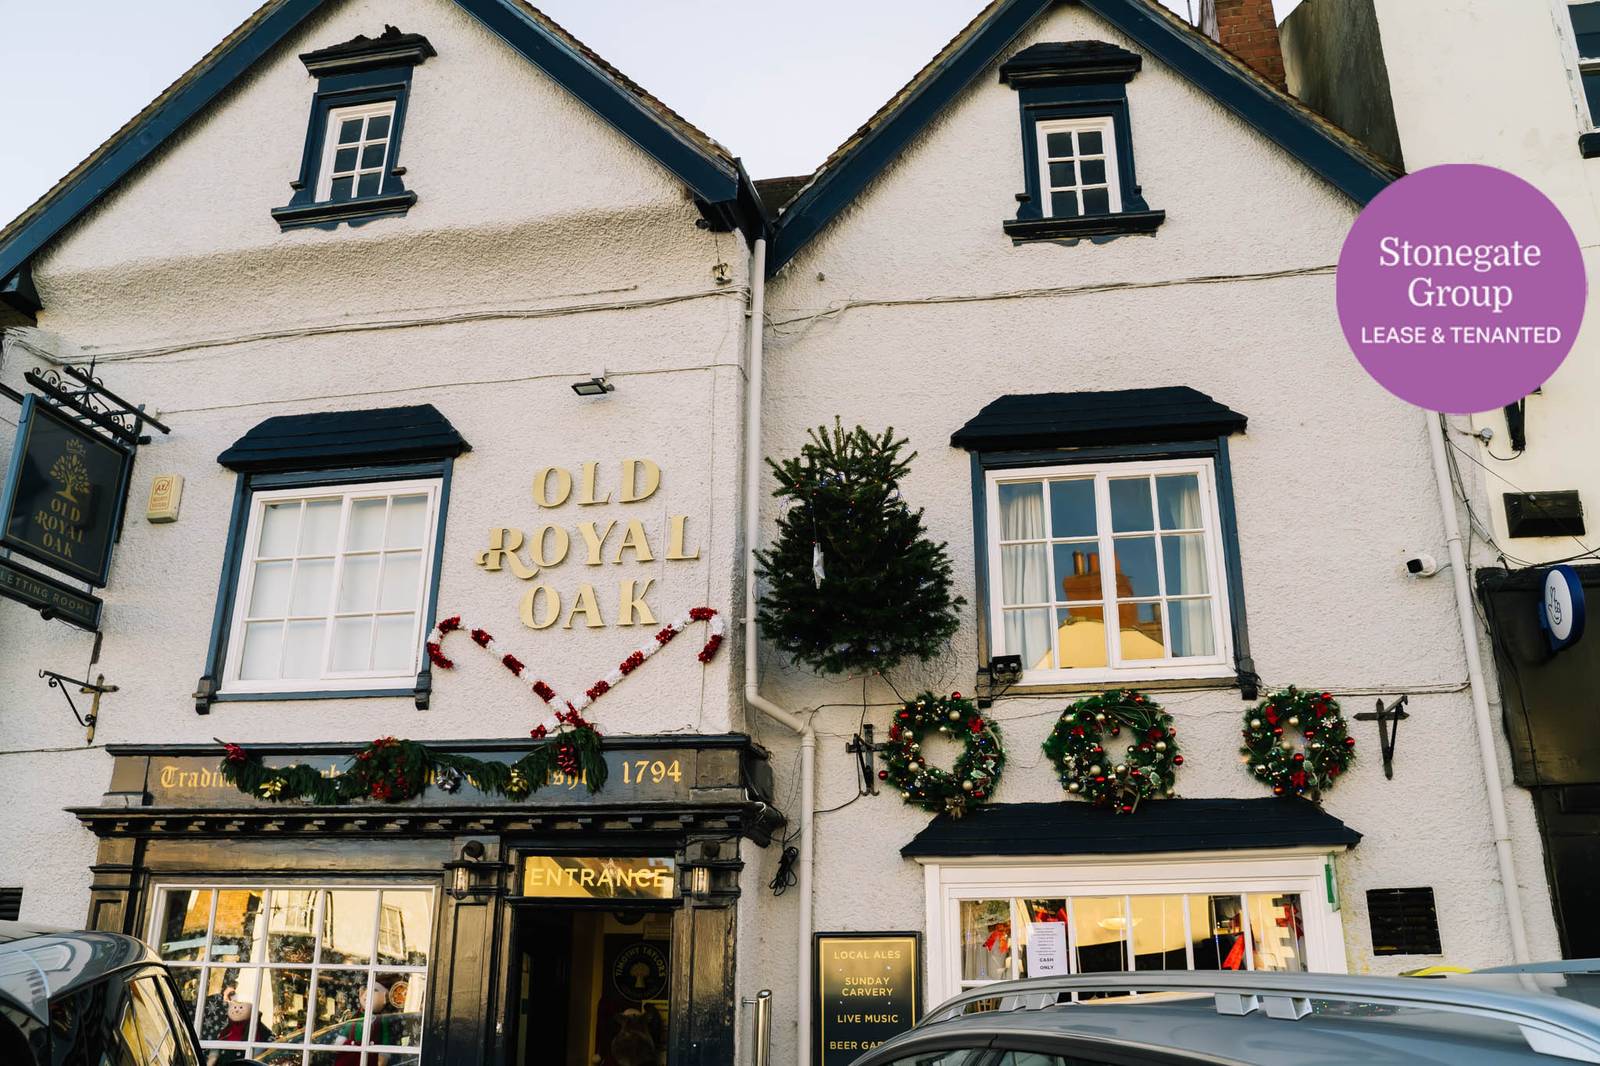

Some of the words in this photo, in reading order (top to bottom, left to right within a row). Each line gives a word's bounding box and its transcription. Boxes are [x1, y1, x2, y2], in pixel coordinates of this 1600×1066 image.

[531, 457, 662, 508] OLD
[51, 498, 81, 522] OLD
[43, 533, 73, 558] OAK
[474, 514, 701, 580] ROYAL
[518, 578, 660, 630] OAK
[621, 759, 682, 785] 1794
[530, 867, 668, 888] ENTRANCE
[834, 951, 870, 960] LOCAL
[873, 950, 901, 960] ALES
[841, 987, 893, 997] CARVERY
[845, 977, 890, 986] SUNDAY
[837, 1014, 861, 1023] LIVE
[864, 1014, 899, 1023] MUSIC
[829, 1041, 858, 1050] BEER
